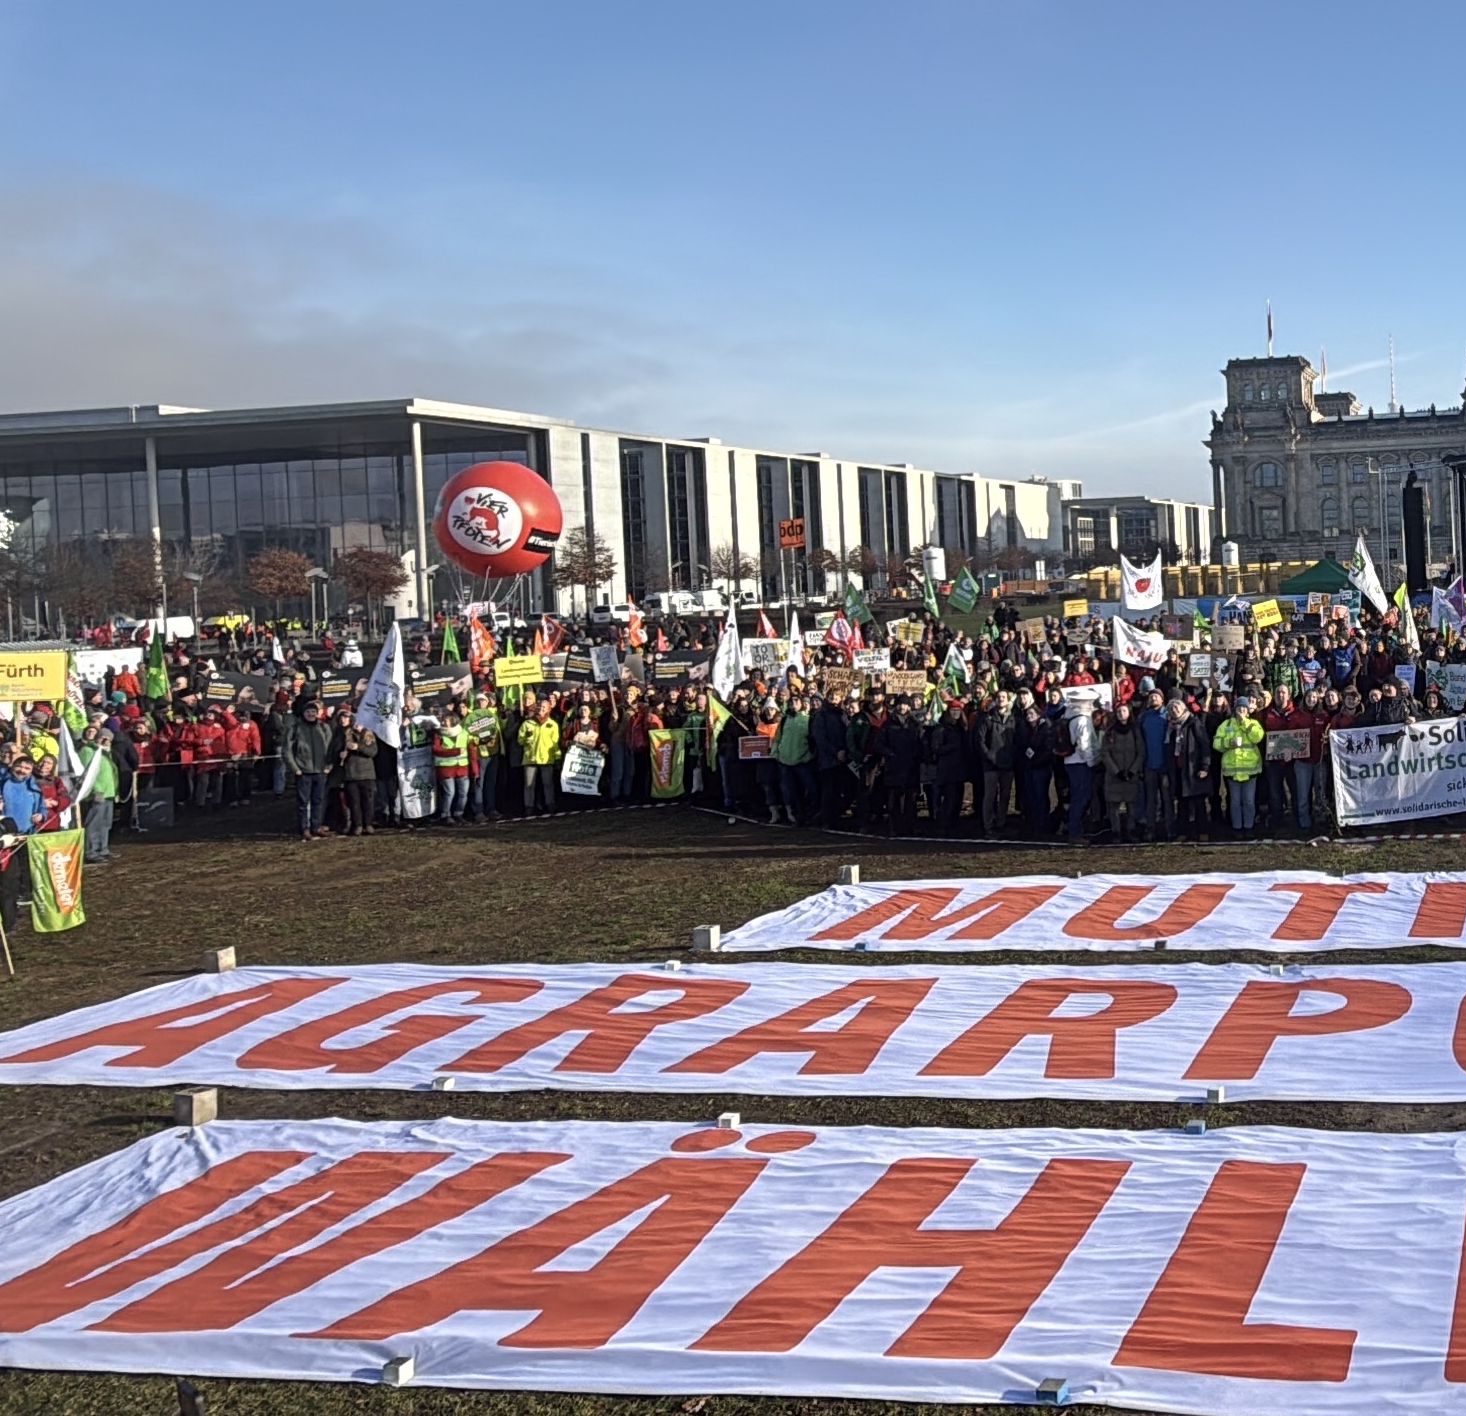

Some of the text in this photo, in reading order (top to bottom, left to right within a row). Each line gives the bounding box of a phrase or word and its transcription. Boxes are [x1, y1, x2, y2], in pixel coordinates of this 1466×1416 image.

[476, 493, 508, 518] VIER
[452, 515, 511, 549] PFOTEN
[754, 645, 767, 654] TO
[1125, 646, 1163, 664] NAJU
[755, 655, 769, 663] OR
[0, 664, 44, 678] Fürth
[51, 852, 74, 907] demeter
